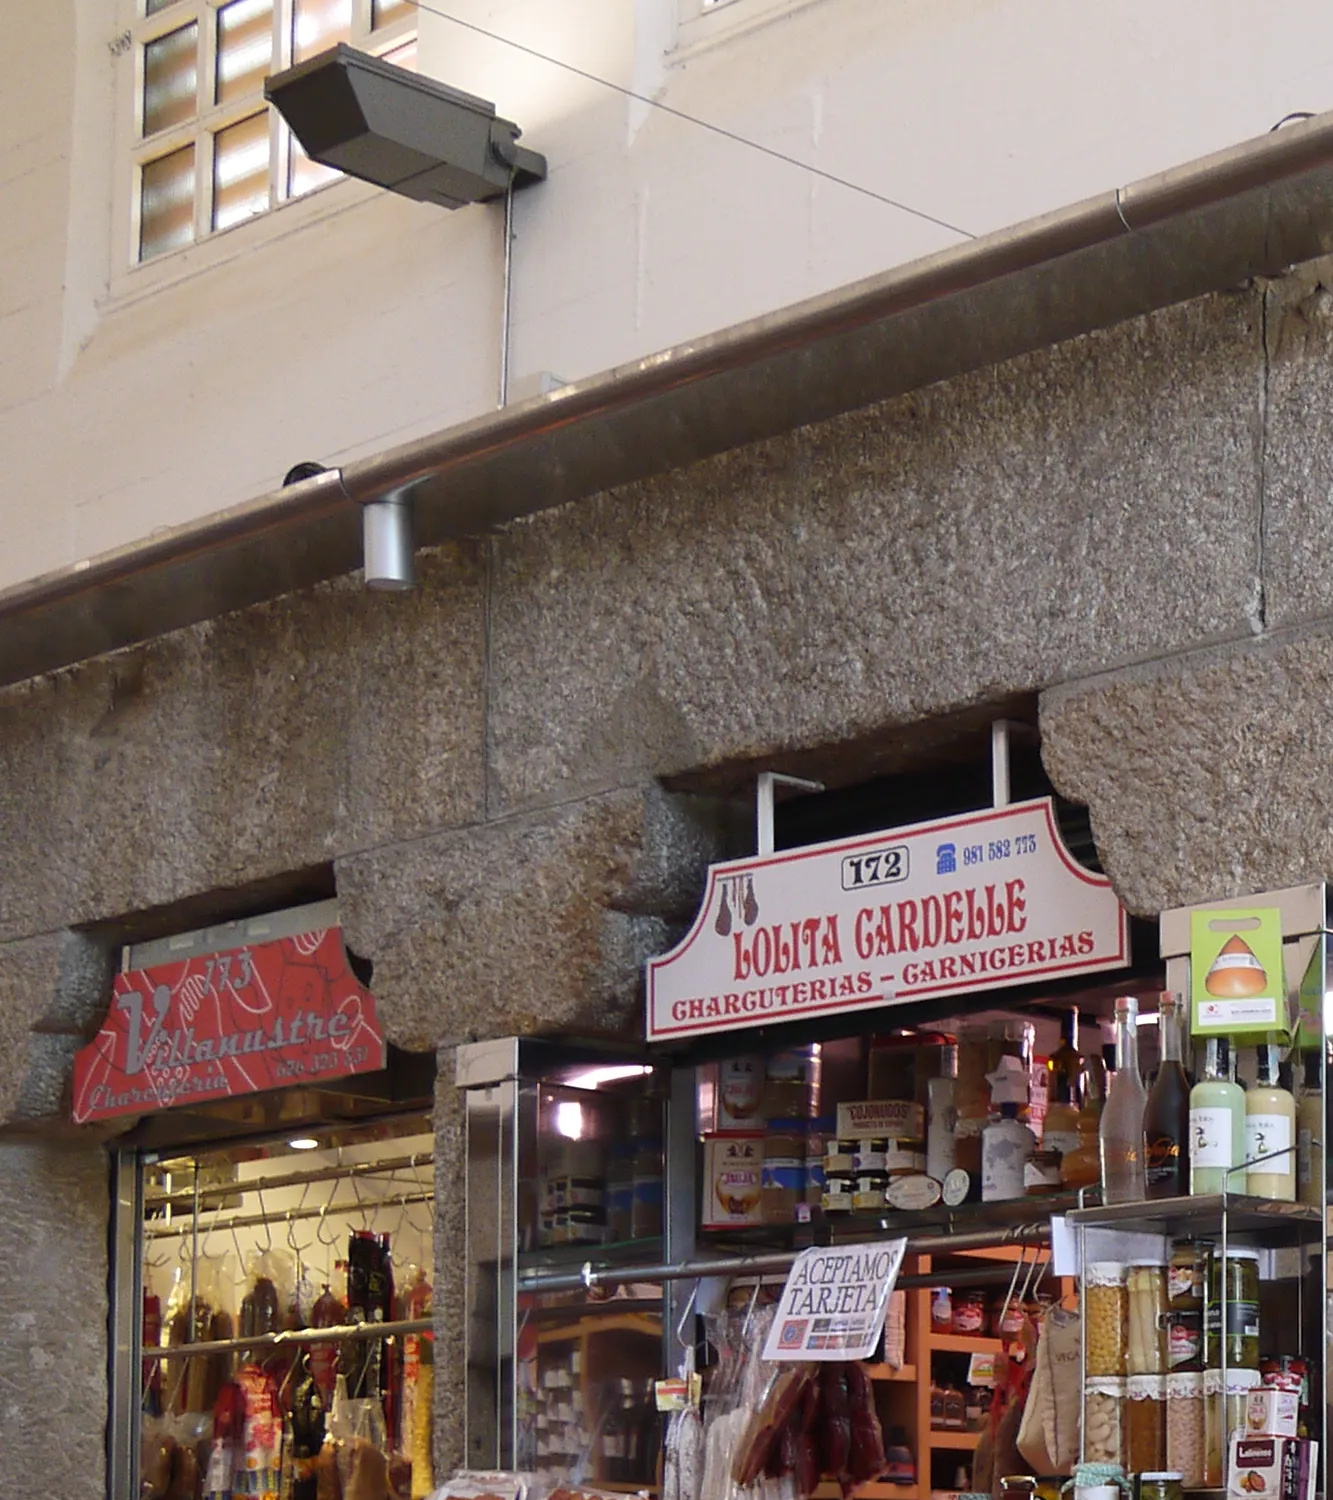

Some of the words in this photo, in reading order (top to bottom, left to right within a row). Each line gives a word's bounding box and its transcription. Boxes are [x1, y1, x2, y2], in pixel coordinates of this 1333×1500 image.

[849, 852, 902, 885] 172
[963, 846, 985, 866] 981
[988, 841, 1012, 862] 582
[733, 914, 843, 981] LOLITA
[855, 878, 1028, 960] CARDELLE
[672, 971, 873, 1021] CHARCUTERIAS
[903, 931, 1096, 986] CARNICERIAS
[787, 1283, 886, 1316] TARJETA
